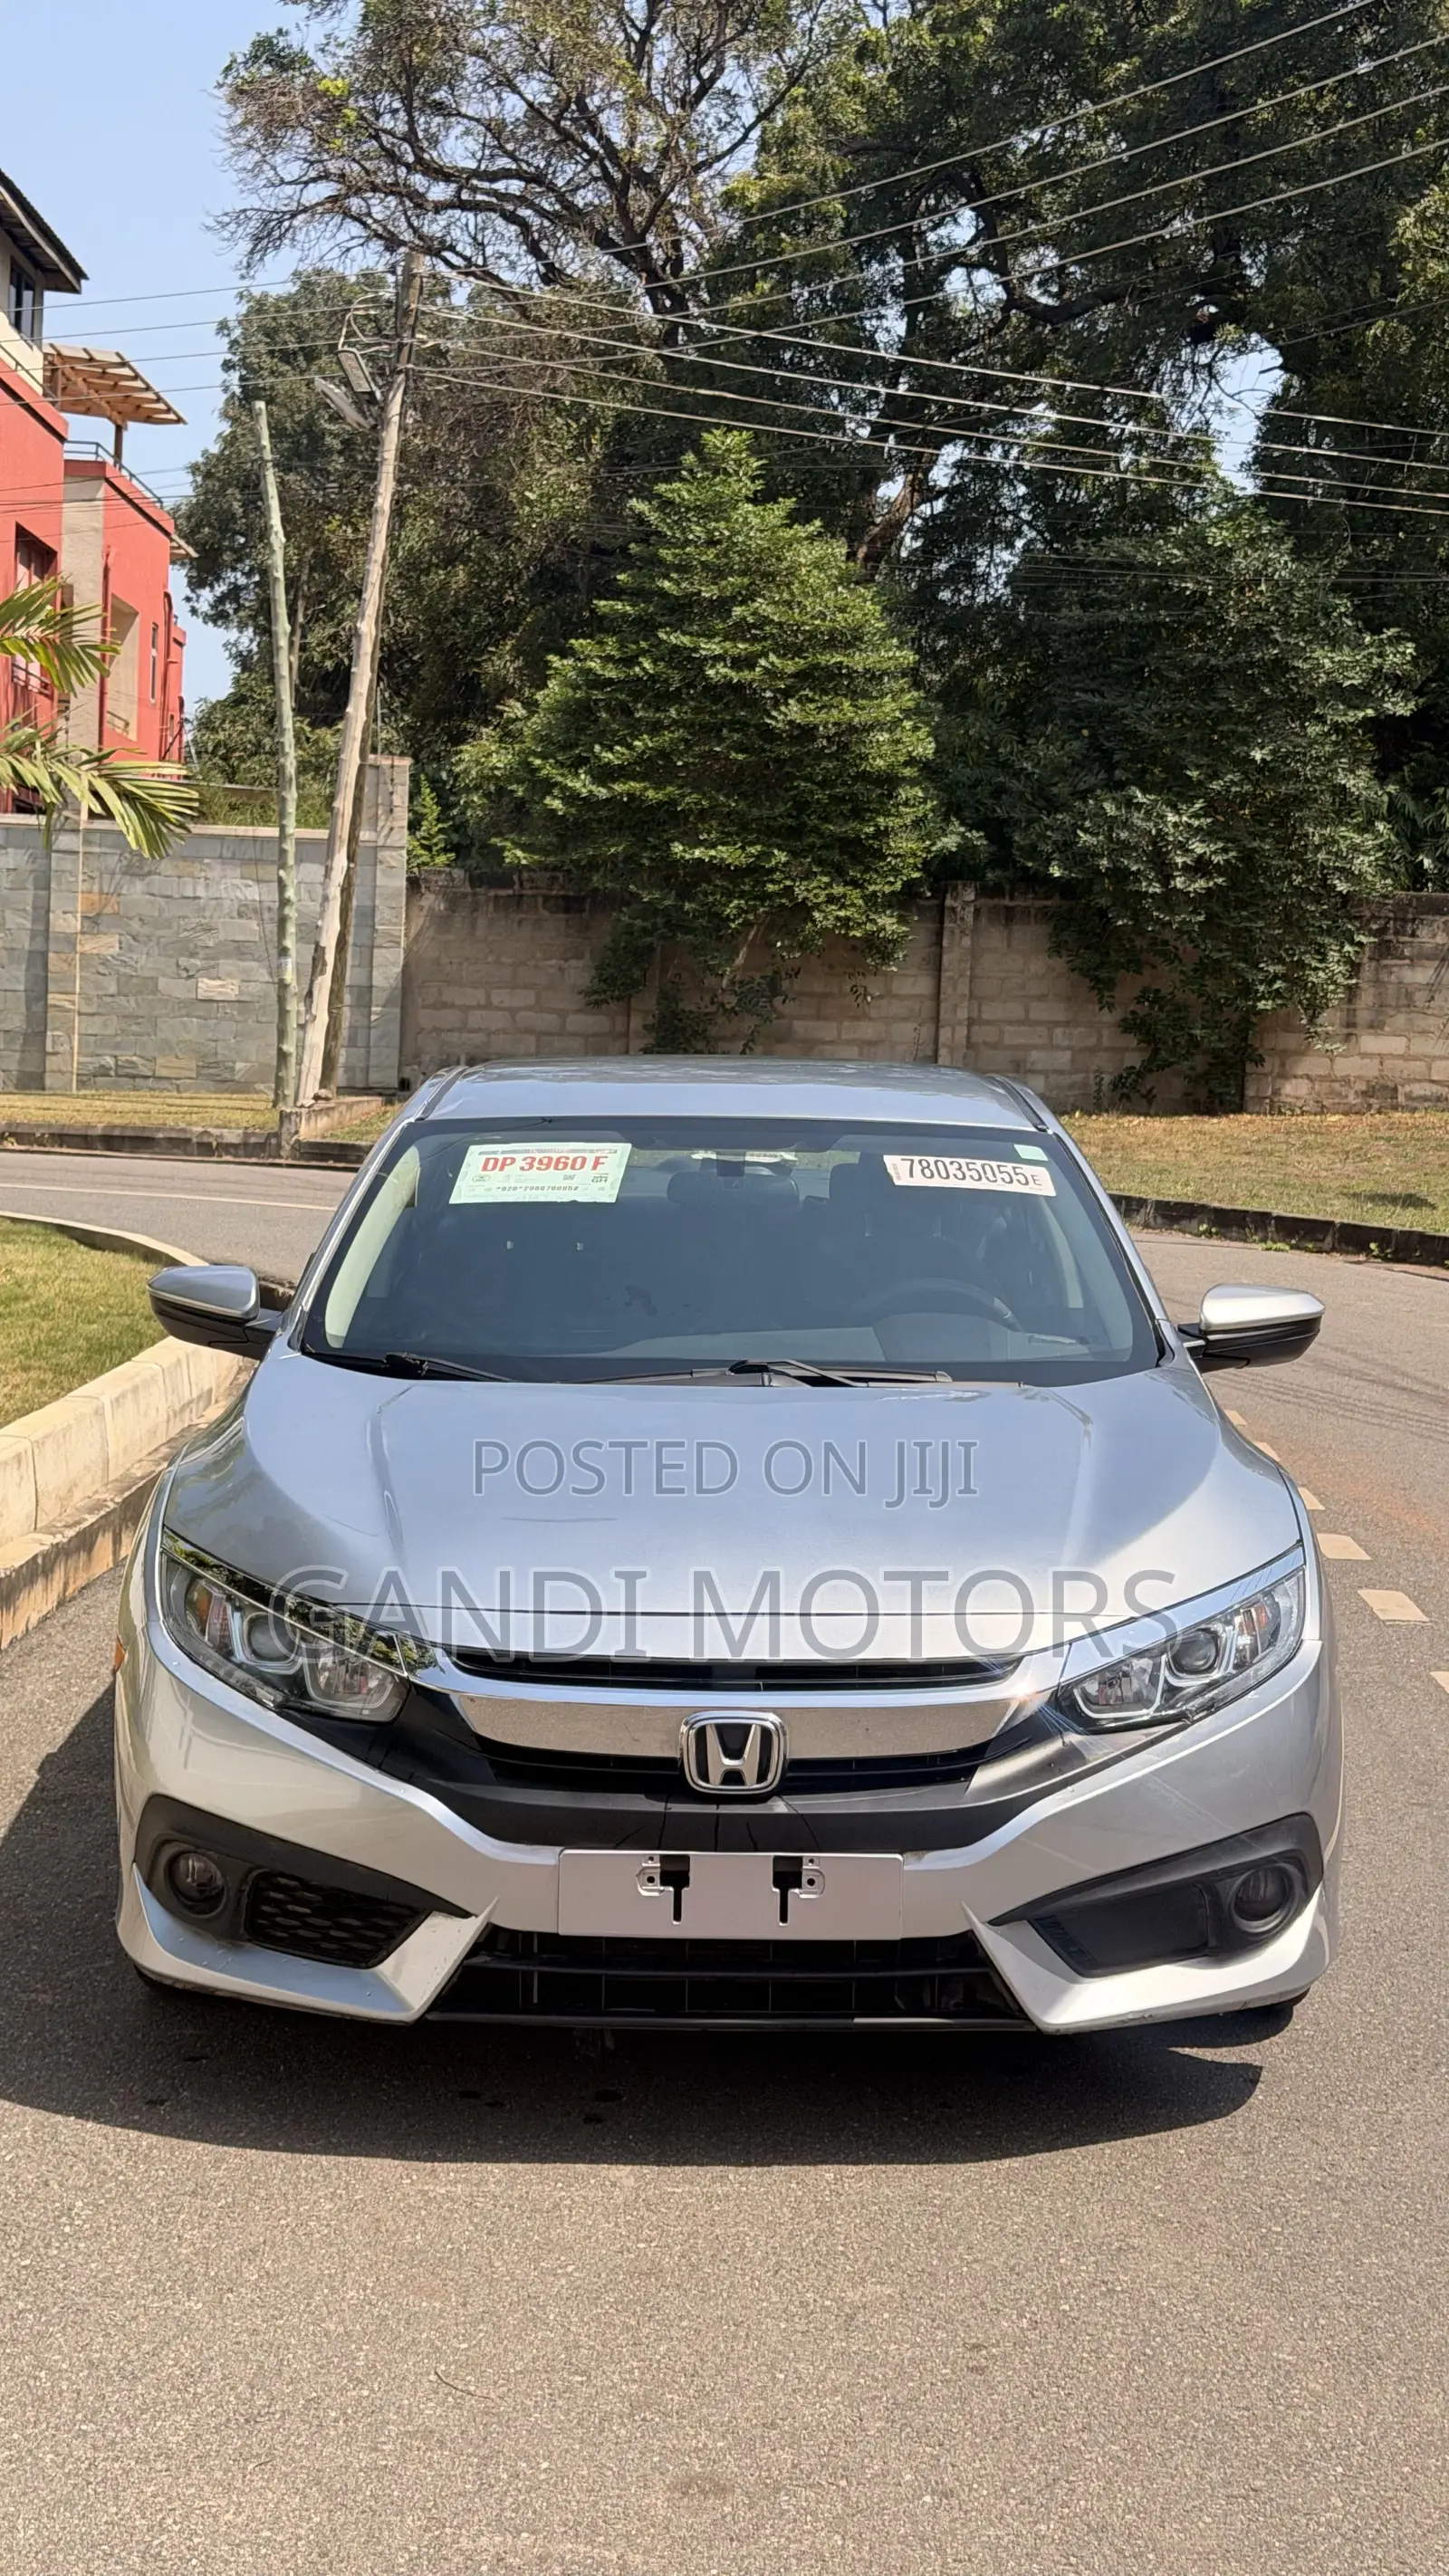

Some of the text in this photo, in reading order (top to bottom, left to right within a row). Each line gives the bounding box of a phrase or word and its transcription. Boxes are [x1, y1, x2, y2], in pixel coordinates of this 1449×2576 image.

[481, 1154, 609, 1173] DP 3960 F
[901, 1157, 1031, 1187] 78035055
[1031, 1173, 1043, 1187] E
